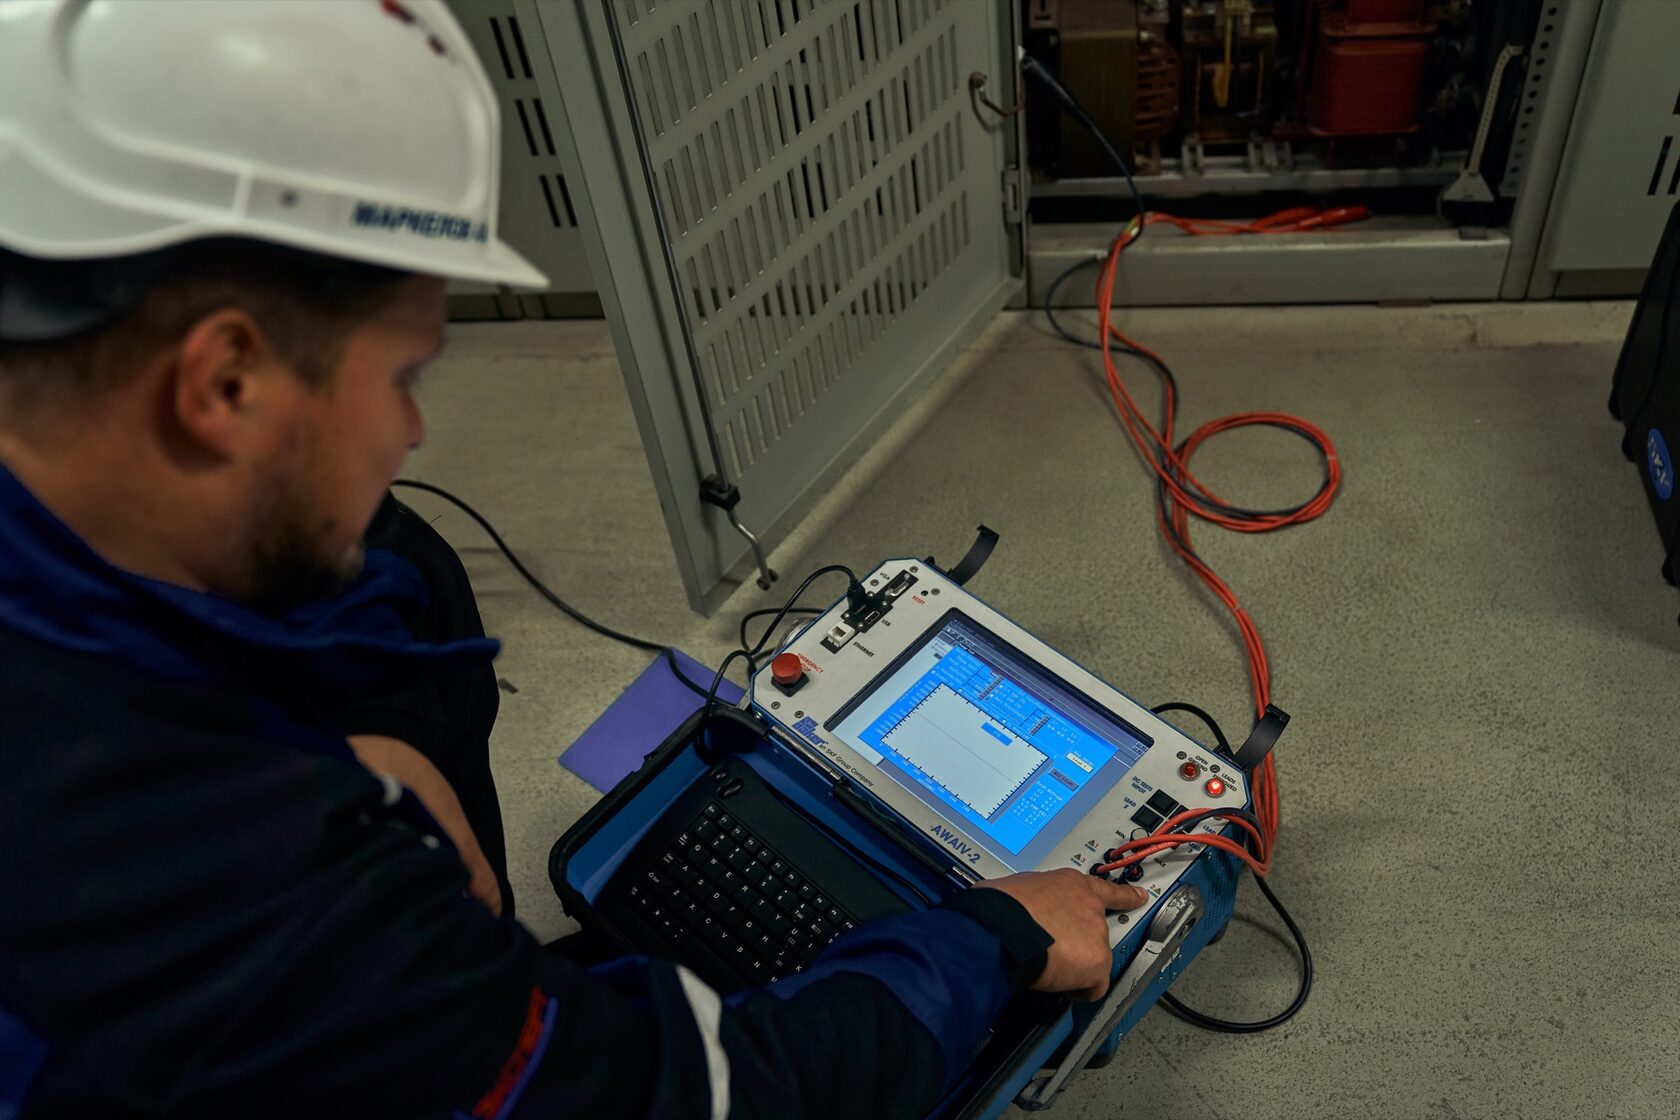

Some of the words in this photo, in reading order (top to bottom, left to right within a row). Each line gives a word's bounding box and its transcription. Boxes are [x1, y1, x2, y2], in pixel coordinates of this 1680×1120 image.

[912, 595, 925, 605] RESET
[882, 619, 891, 627] USB
[853, 642, 874, 657] ETHERNET
[1195, 756, 1208, 766] OPEN
[826, 749, 838, 757] SKF
[836, 757, 851, 769] Group
[851, 768, 873, 787] Company
[1222, 774, 1236, 784] LEADS
[1124, 797, 1136, 807] LEAD
[1115, 830, 1126, 839] MIN
[1154, 858, 1167, 868] MAX
